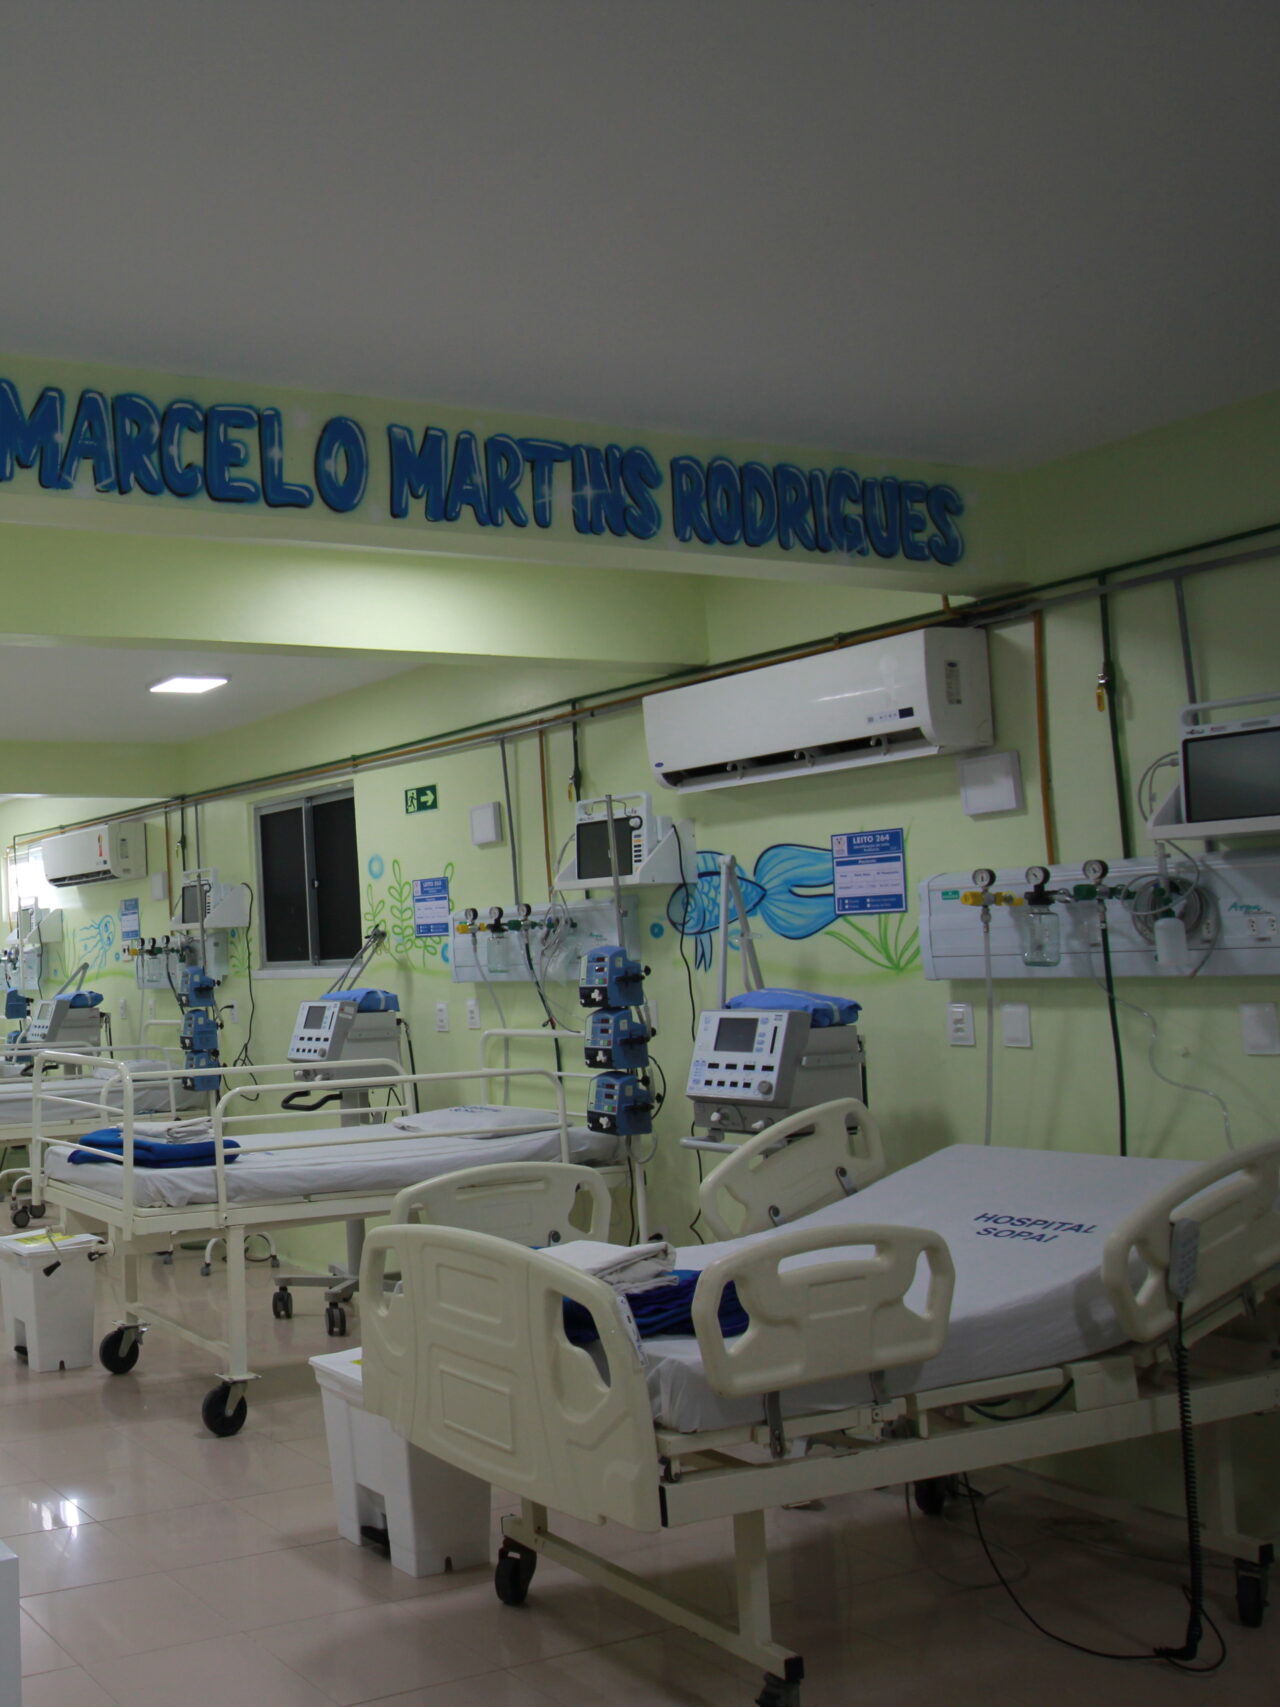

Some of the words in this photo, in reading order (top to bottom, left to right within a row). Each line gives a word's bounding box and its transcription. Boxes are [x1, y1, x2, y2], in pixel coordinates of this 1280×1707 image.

[387, 423, 663, 539] MARTINS
[671, 455, 965, 566] RODRIGUES
[852, 835, 873, 844] LEITO
[974, 1212, 1097, 1234] HOSPITAL
[976, 1226, 1059, 1243] SOPAI
